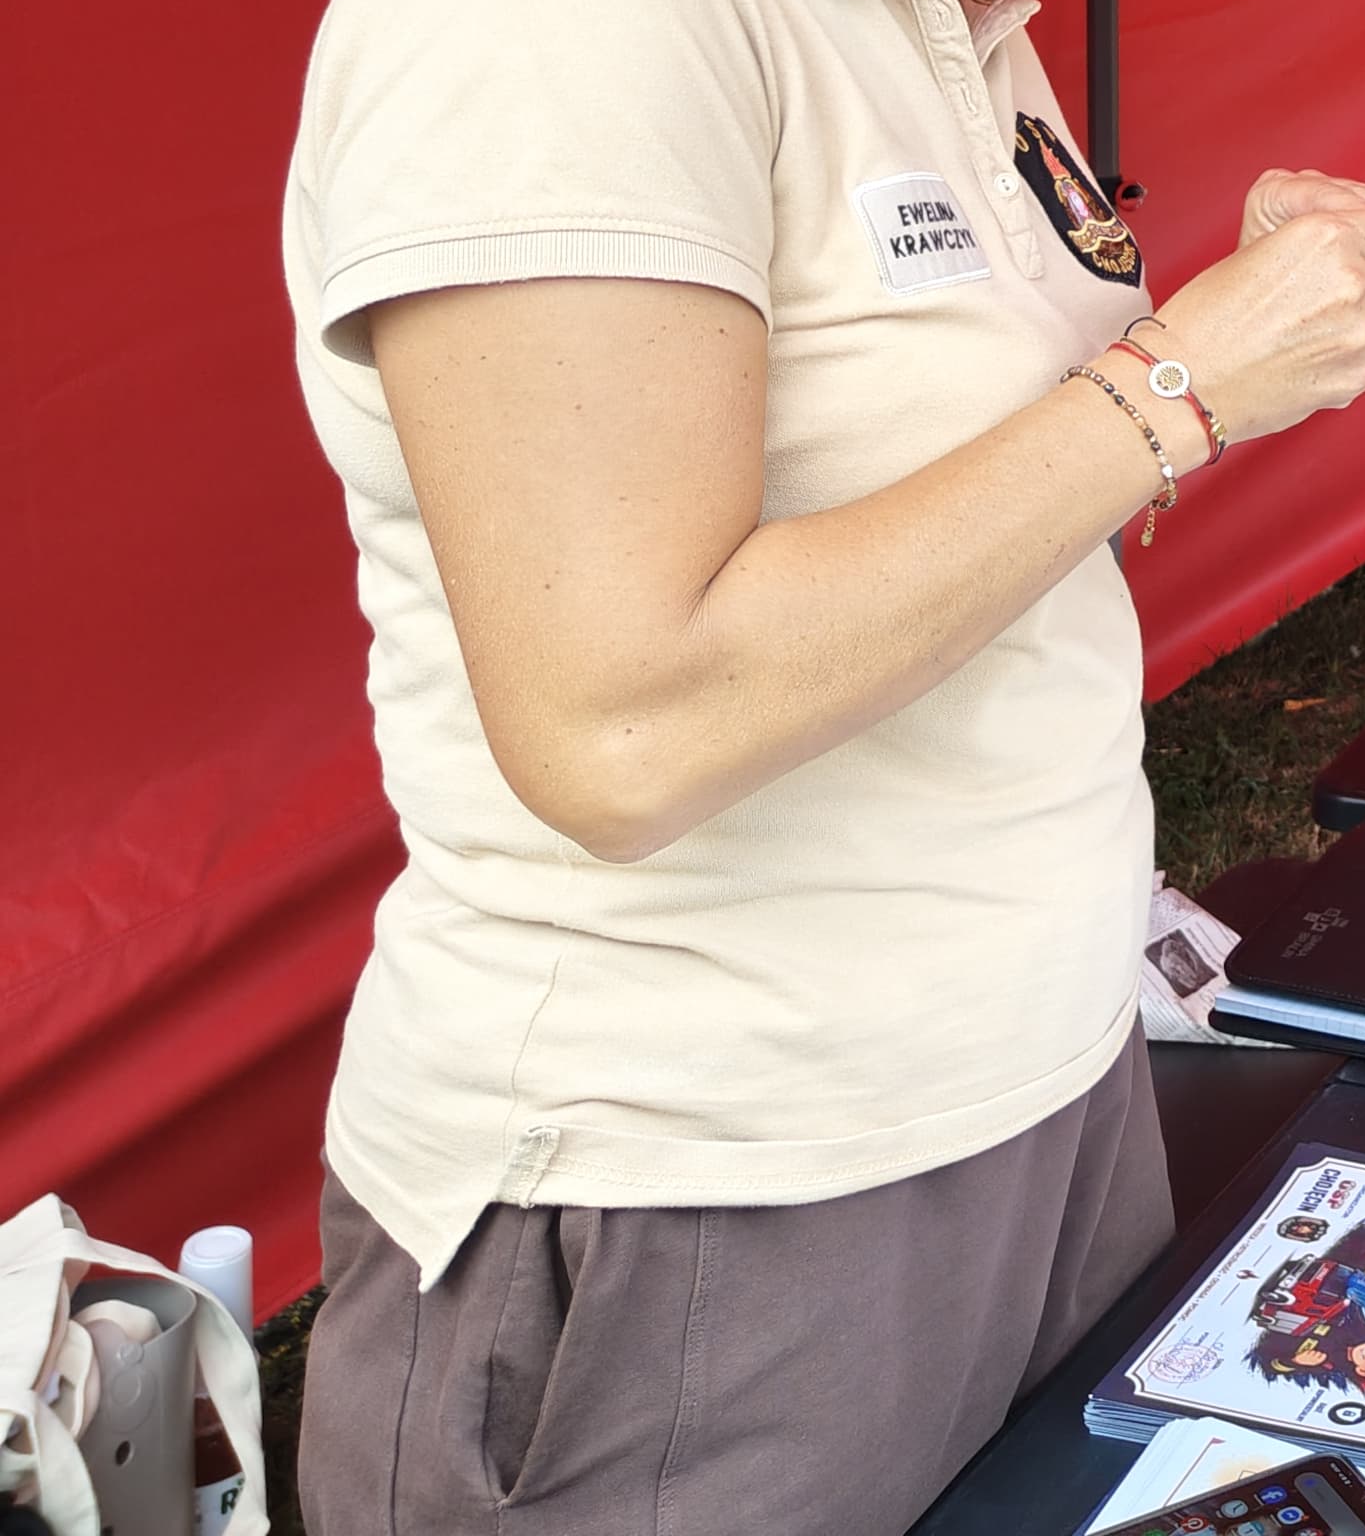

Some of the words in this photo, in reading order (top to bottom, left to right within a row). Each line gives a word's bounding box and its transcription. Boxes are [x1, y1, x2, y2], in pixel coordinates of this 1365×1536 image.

[897, 201, 958, 226] EWELINA
[1296, 1168, 1342, 1212] CHOJĘCIN
[1323, 1179, 1359, 1209] OSP
